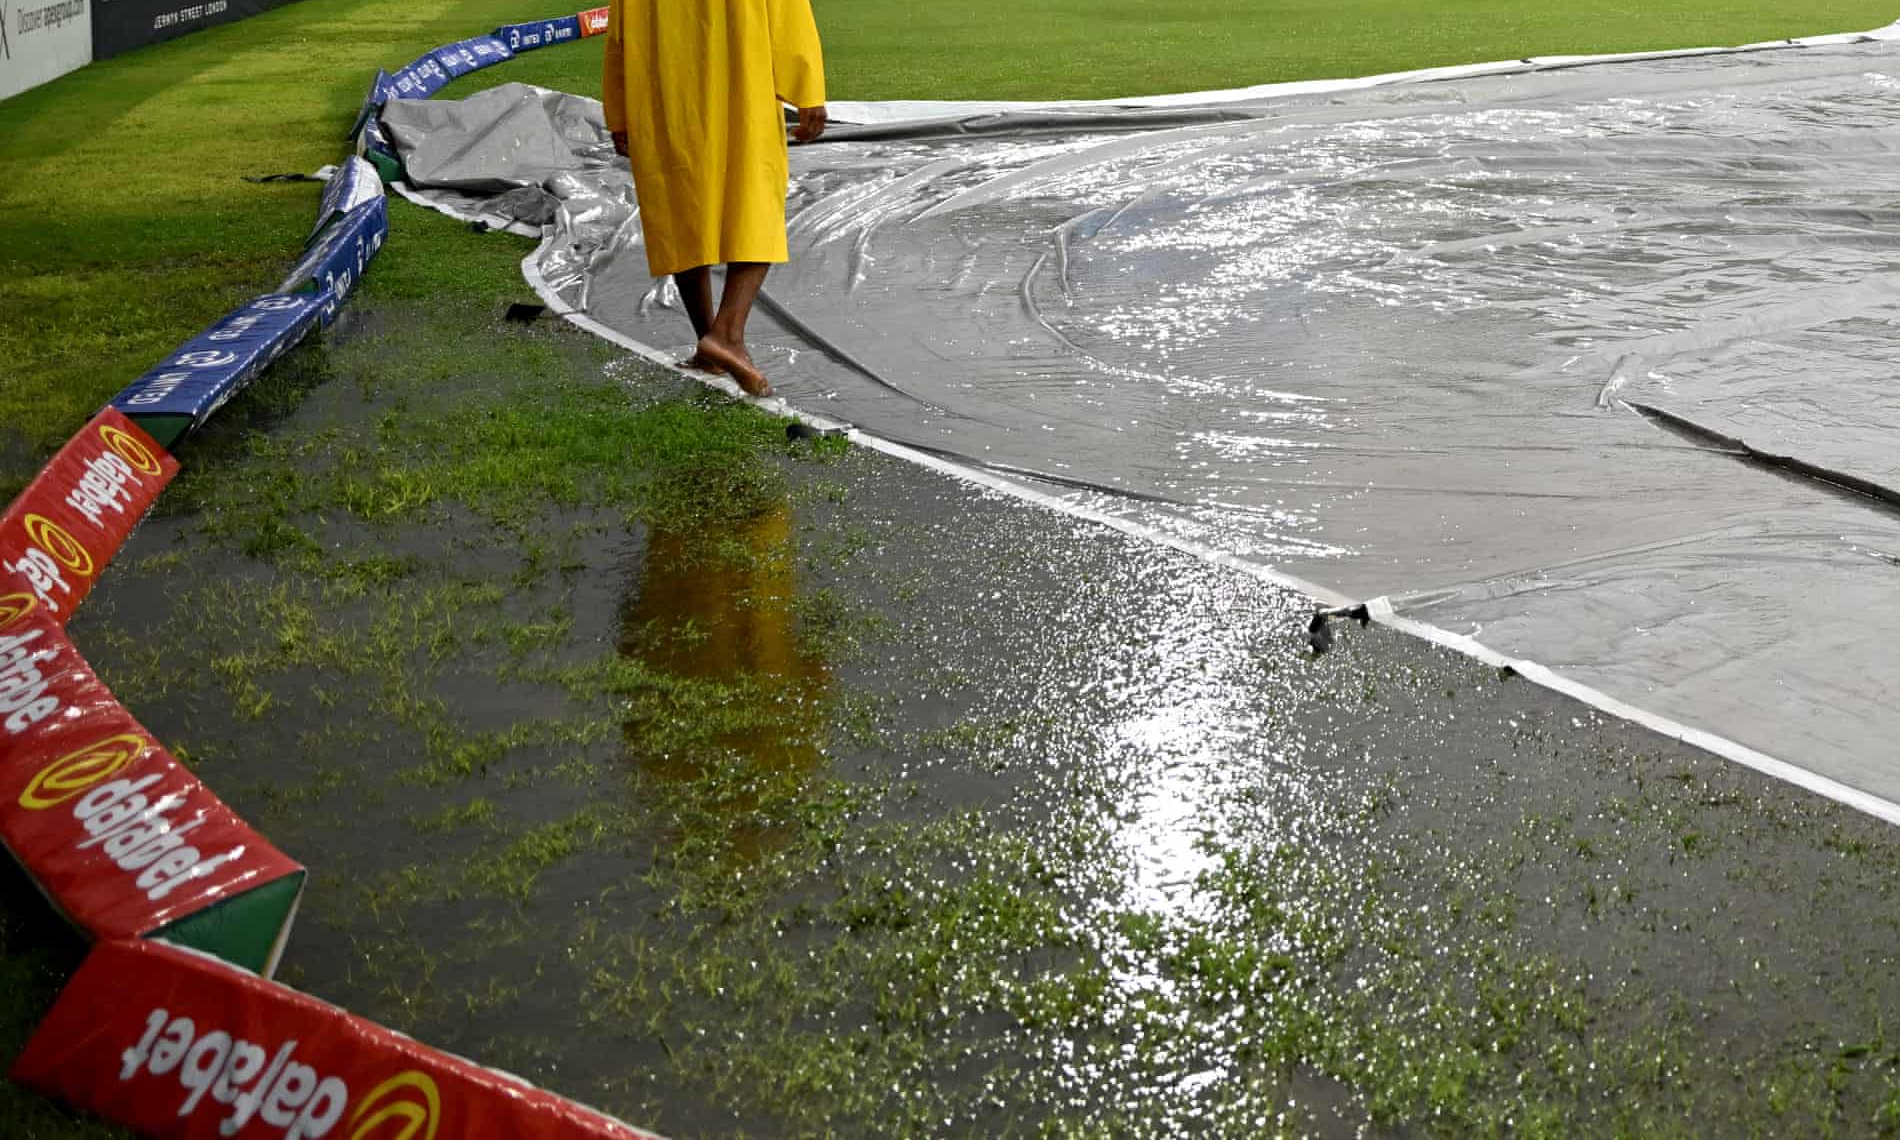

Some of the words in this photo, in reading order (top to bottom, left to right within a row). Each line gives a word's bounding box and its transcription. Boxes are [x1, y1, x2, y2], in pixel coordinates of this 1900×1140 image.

[181, 4, 203, 22] STREET
[65, 451, 143, 528] dafabet
[73, 774, 246, 901] dafabet
[119, 1008, 348, 1140] dafabet
